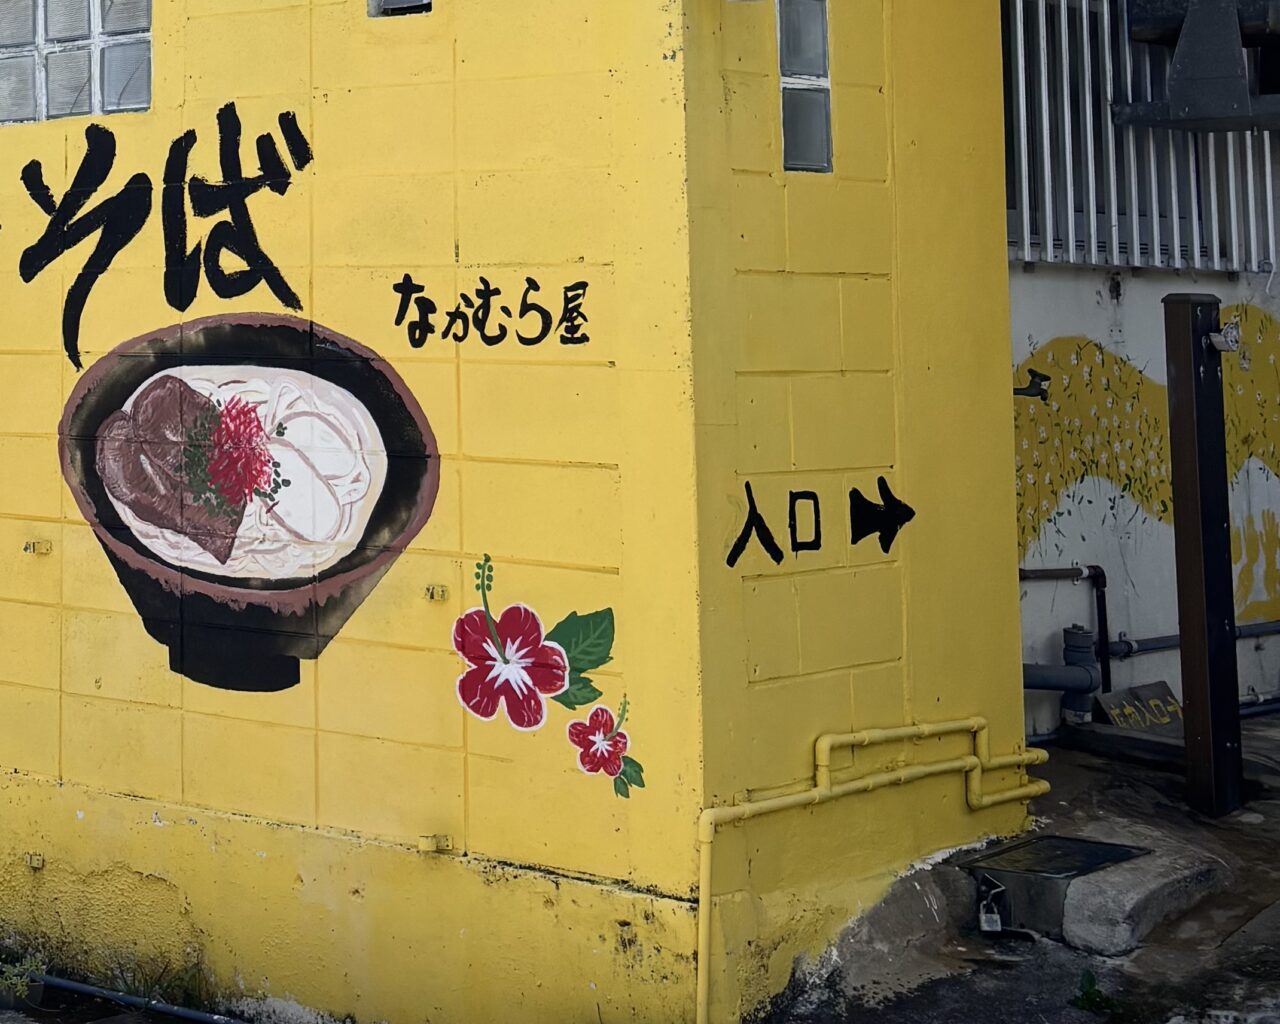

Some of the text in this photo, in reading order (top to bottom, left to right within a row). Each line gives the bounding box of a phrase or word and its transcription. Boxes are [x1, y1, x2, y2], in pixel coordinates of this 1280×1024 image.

[392, 272, 590, 349] なかむら屋
[726, 480, 822, 567] 入口
